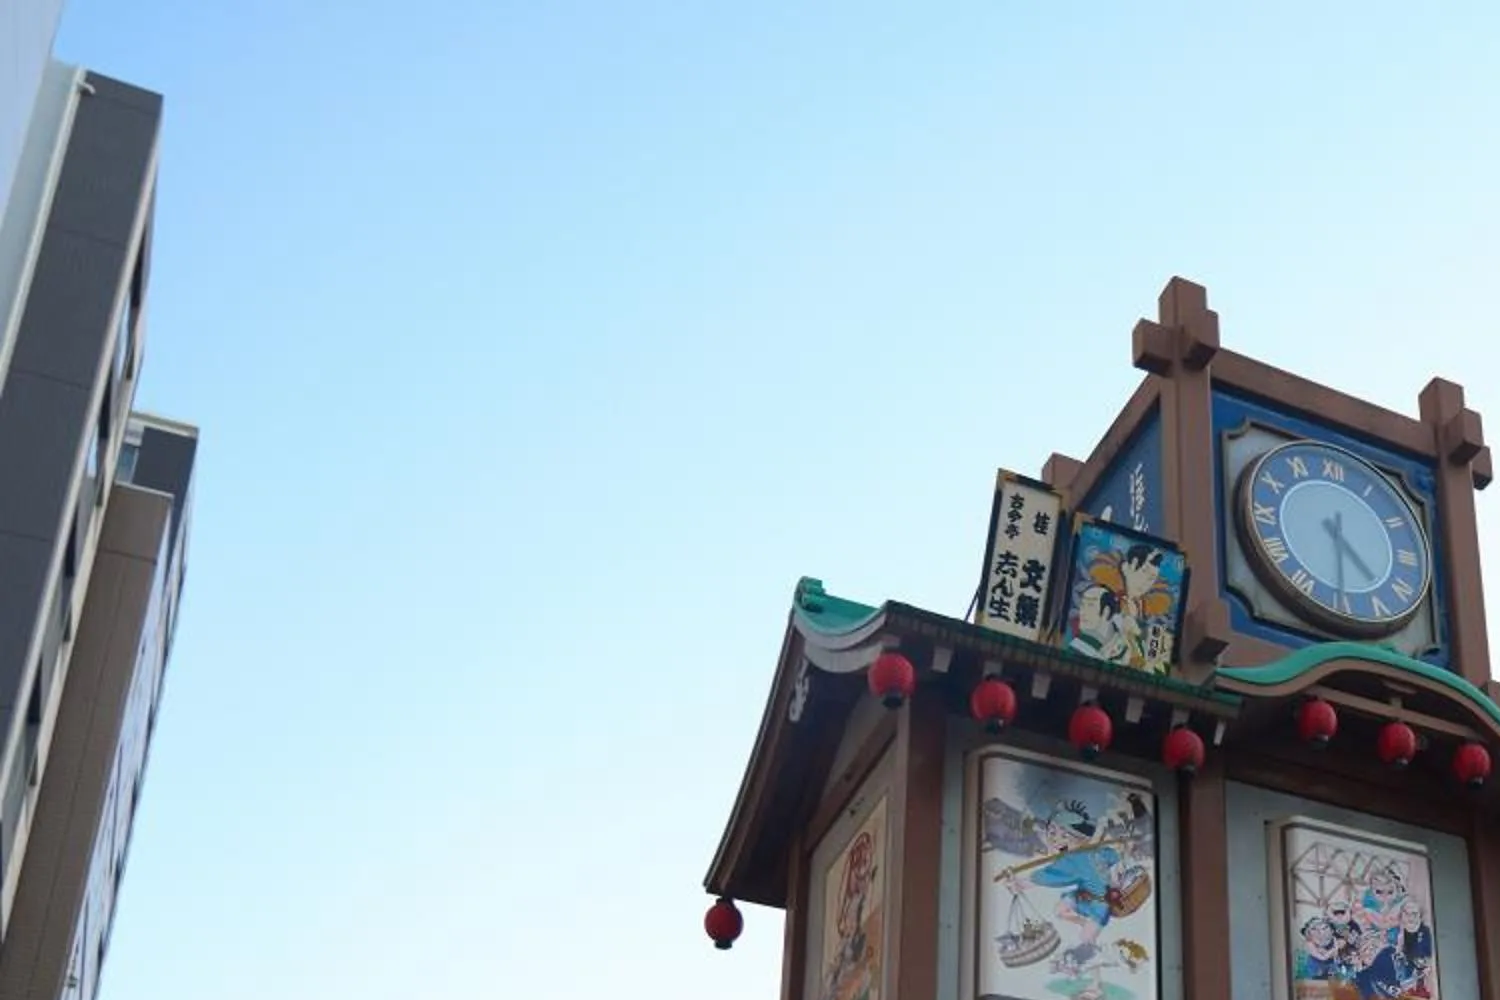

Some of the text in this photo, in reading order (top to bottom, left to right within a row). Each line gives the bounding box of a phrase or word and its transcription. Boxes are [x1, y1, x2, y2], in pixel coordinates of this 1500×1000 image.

[1322, 459, 1344, 481] XII
[1262, 472, 1284, 494] X
[1385, 516, 1403, 528] II
[1398, 550, 1418, 566] III
